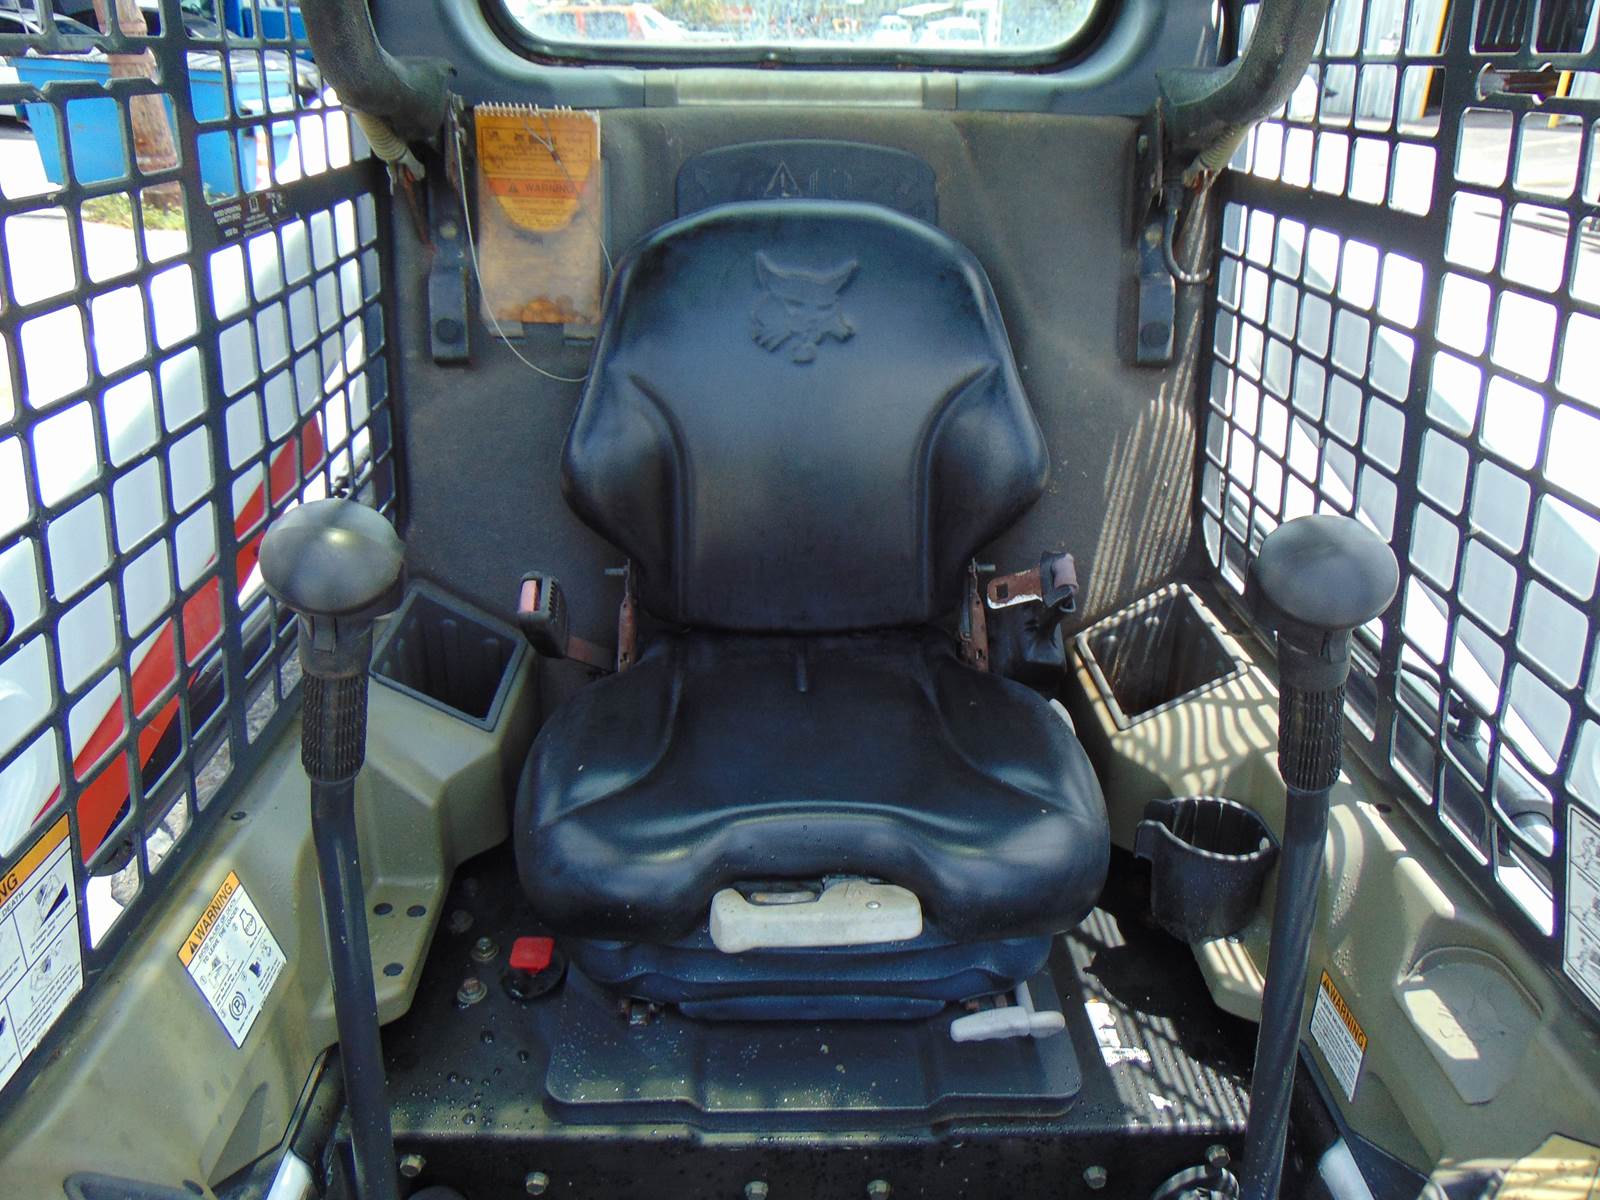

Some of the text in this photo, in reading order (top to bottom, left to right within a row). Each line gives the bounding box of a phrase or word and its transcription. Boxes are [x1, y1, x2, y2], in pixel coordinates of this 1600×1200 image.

[525, 183, 576, 193] WARNING
[195, 882, 233, 940] WARNING
[202, 905, 239, 965] TO LEAVE THE LOADER
[1329, 986, 1364, 1047] WARNING
